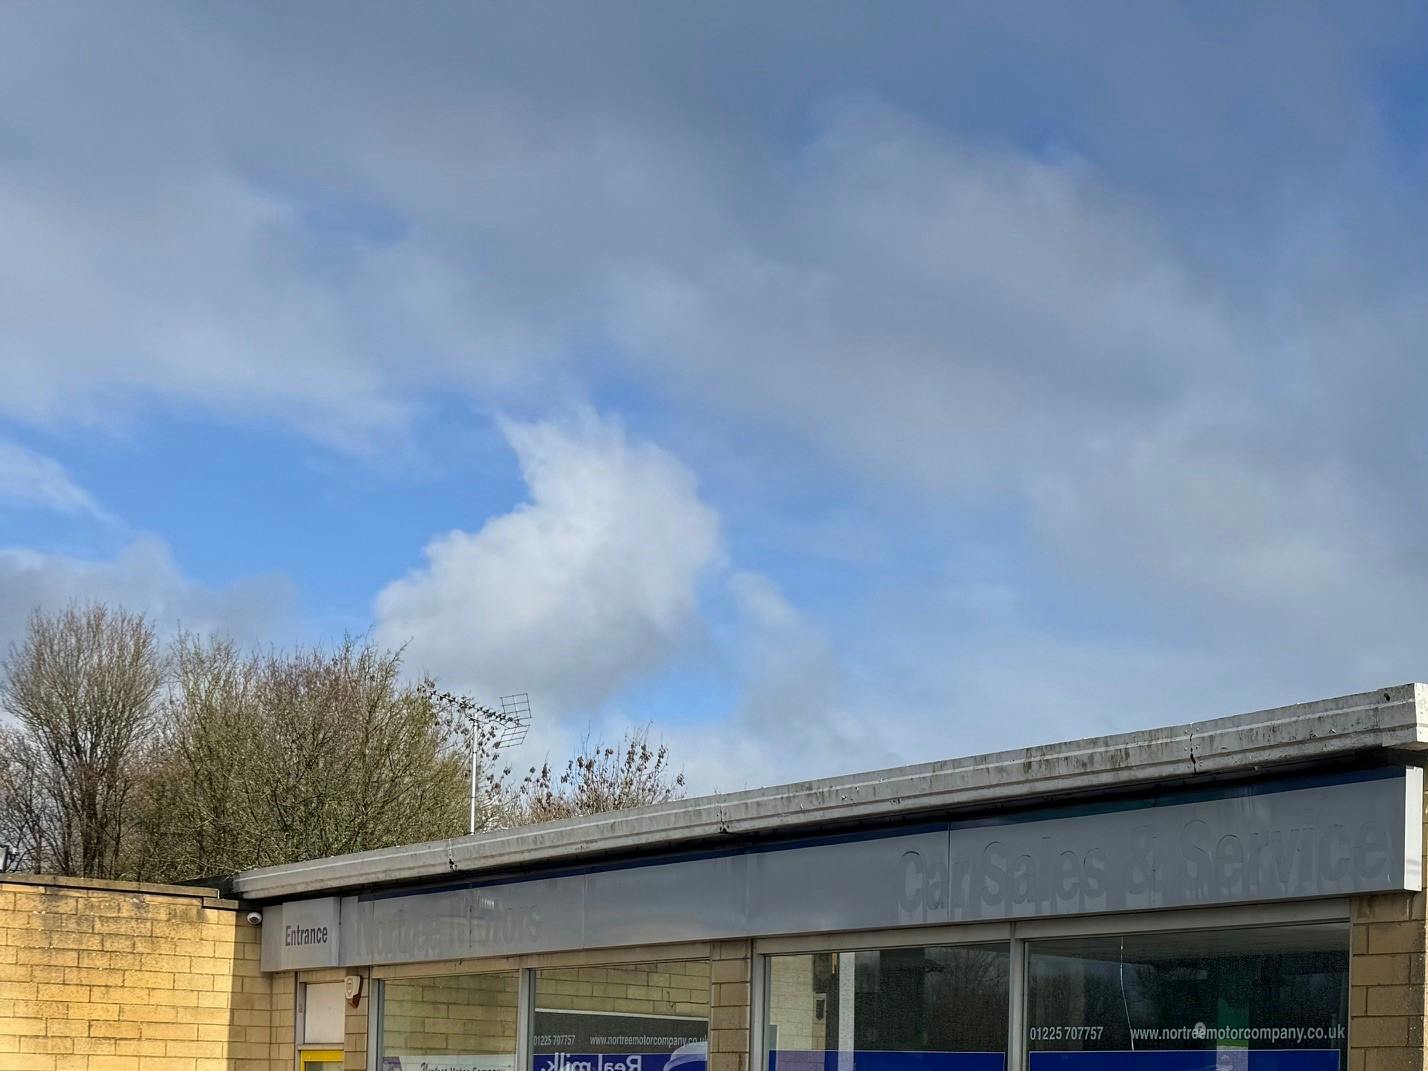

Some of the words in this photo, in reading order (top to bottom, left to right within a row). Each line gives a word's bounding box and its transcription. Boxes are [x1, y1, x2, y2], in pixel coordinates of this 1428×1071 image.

[981, 836, 1106, 906] Sales
[1180, 818, 1390, 890] Service
[285, 925, 328, 946] Entrance
[1029, 1026, 1062, 1041] 01225
[1064, 1026, 1104, 1040] 707757
[1129, 1024, 1346, 1047] www.nortreemotorcompany.co.uk
